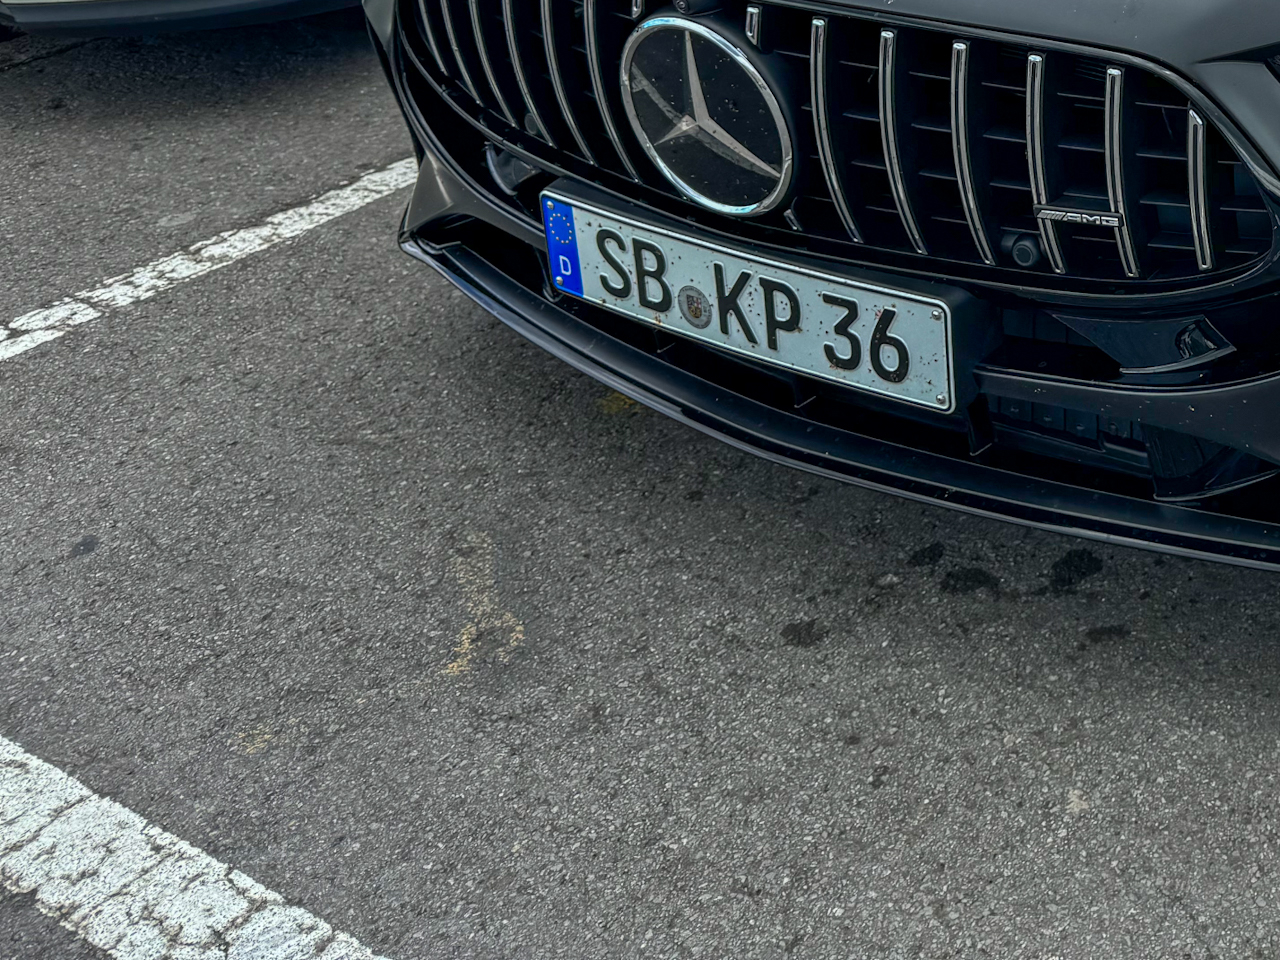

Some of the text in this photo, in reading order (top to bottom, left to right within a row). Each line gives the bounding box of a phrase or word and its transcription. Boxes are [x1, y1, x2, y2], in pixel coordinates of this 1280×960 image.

[1063, 212, 1119, 227] AMG
[558, 254, 573, 276] D
[596, 228, 673, 313] SB
[713, 262, 801, 350] KP
[822, 292, 910, 383] 36
